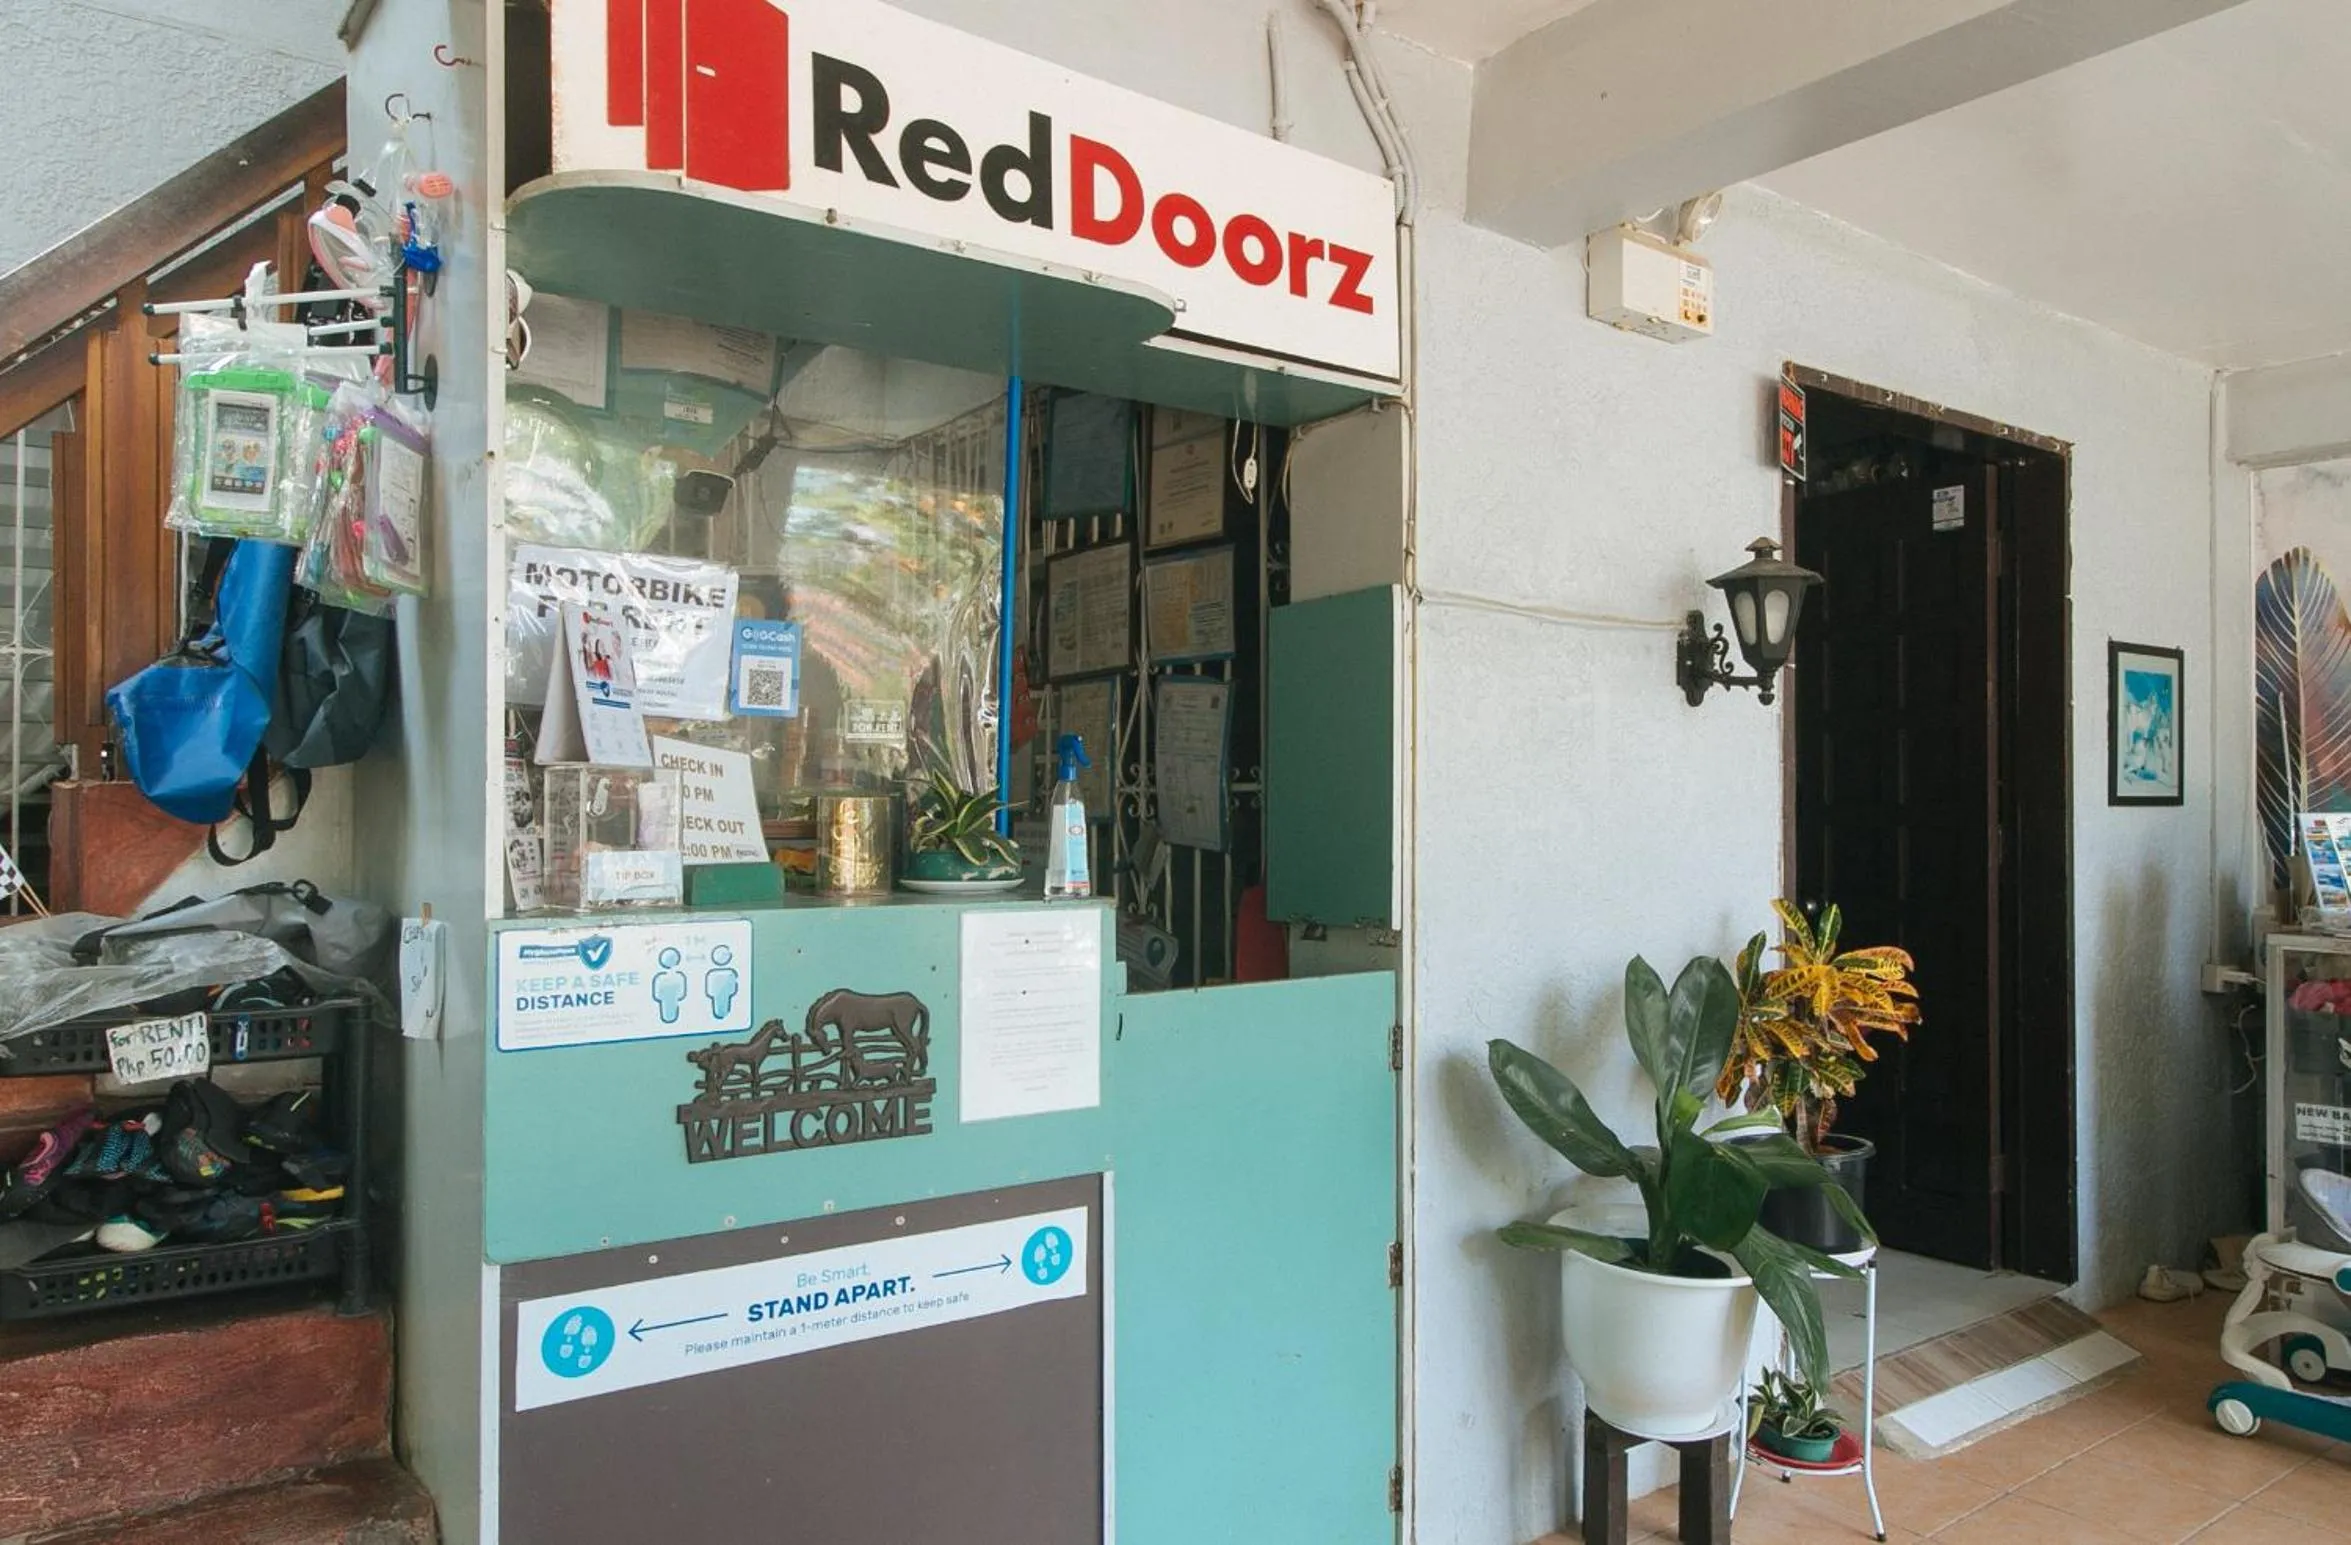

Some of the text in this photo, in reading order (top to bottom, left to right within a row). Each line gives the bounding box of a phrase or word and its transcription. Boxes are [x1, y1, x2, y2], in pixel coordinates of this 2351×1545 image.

[811, 50, 1375, 316] RedDoorz
[525, 562, 727, 609] MOTORBIKE
[661, 753, 724, 778] CHECK IN
[694, 785, 714, 801] PM
[682, 815, 745, 835] ECK OUT
[711, 844, 732, 859] PM
[516, 972, 640, 993] KEEP A SAFE
[516, 991, 615, 1012] DISTANCE
[139, 1014, 205, 1044] RENT!
[150, 1042, 206, 1070] 50.00
[2296, 1107, 2329, 1118] NEW
[685, 1095, 934, 1164] WELCOME
[796, 1272, 818, 1289] Be
[747, 1275, 916, 1322] STAND APART.
[684, 1291, 970, 1356] Please maintain a 1-meter distance to keep safe
